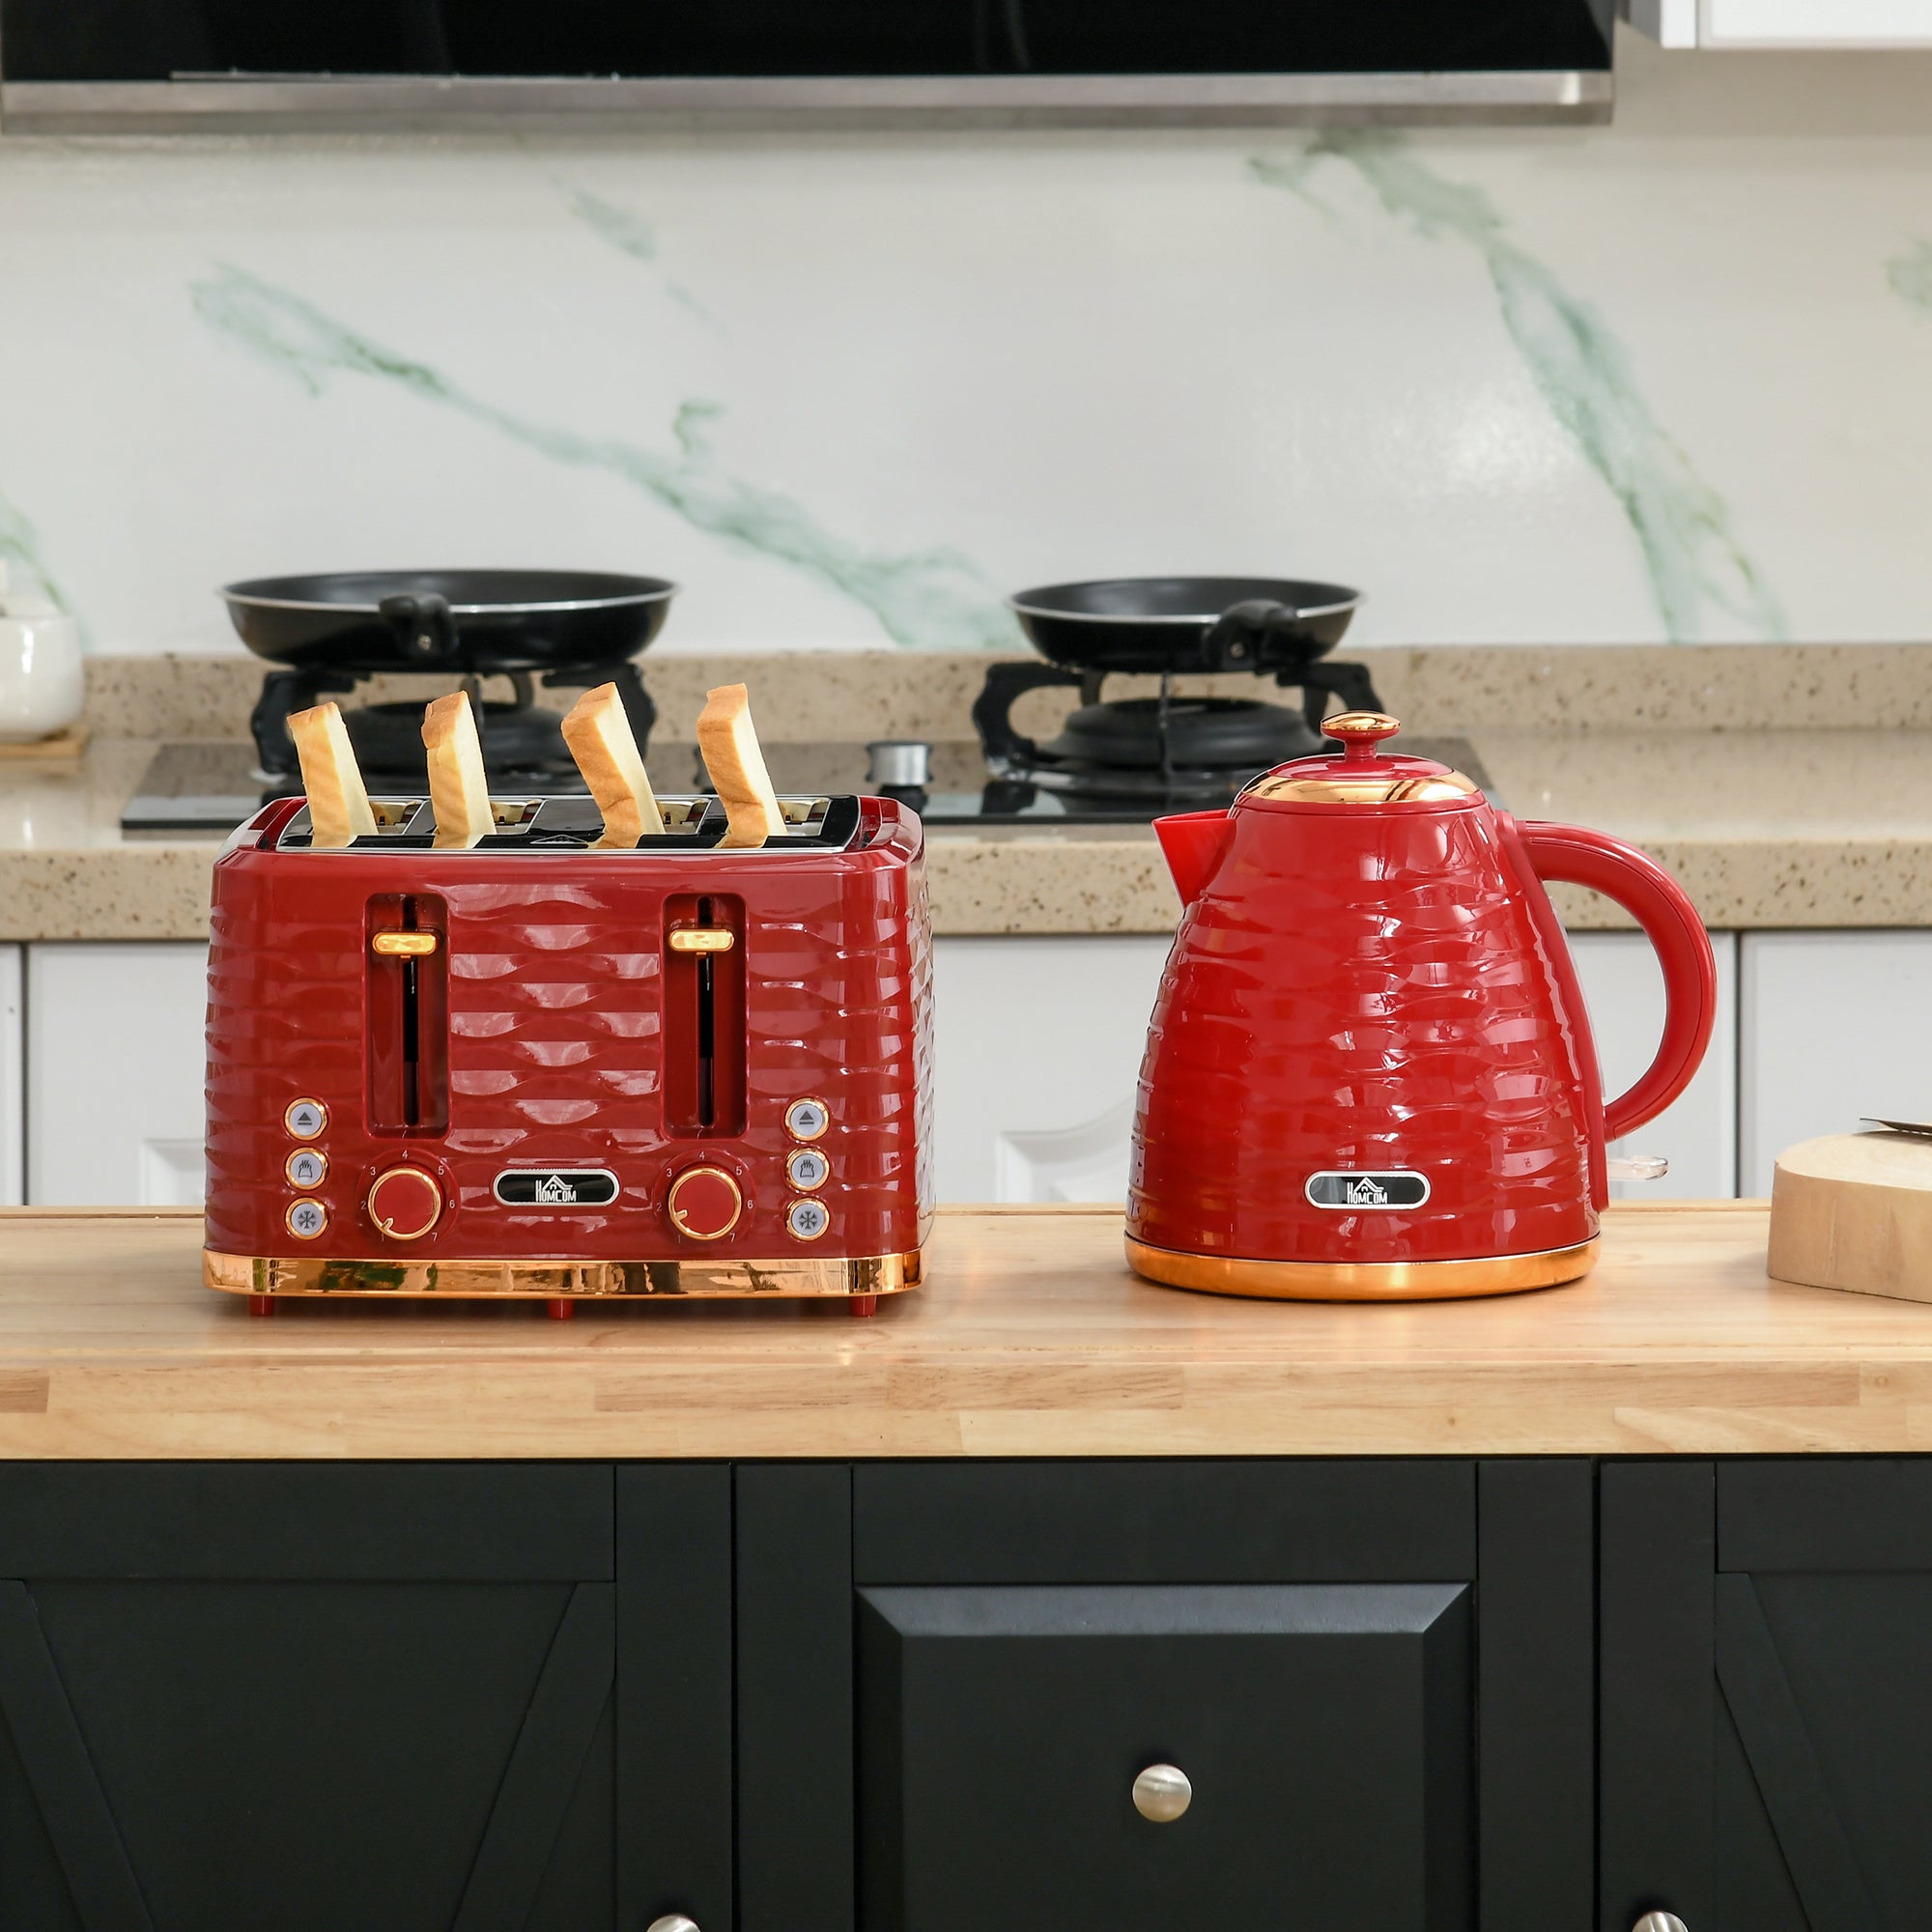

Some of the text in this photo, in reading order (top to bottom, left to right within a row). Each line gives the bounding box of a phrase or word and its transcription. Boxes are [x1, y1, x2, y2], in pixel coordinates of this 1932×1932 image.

[402, 1150, 408, 1159] 4
[370, 1167, 376, 1176] 3
[438, 1166, 444, 1176] 5
[667, 1168, 671, 1177] 3
[735, 1166, 742, 1176] 5
[360, 1201, 366, 1209] 2
[449, 1200, 455, 1208] 6
[657, 1203, 662, 1211] 2
[748, 1200, 753, 1208] 6
[432, 1232, 438, 1241] 7
[730, 1233, 735, 1242] 7
